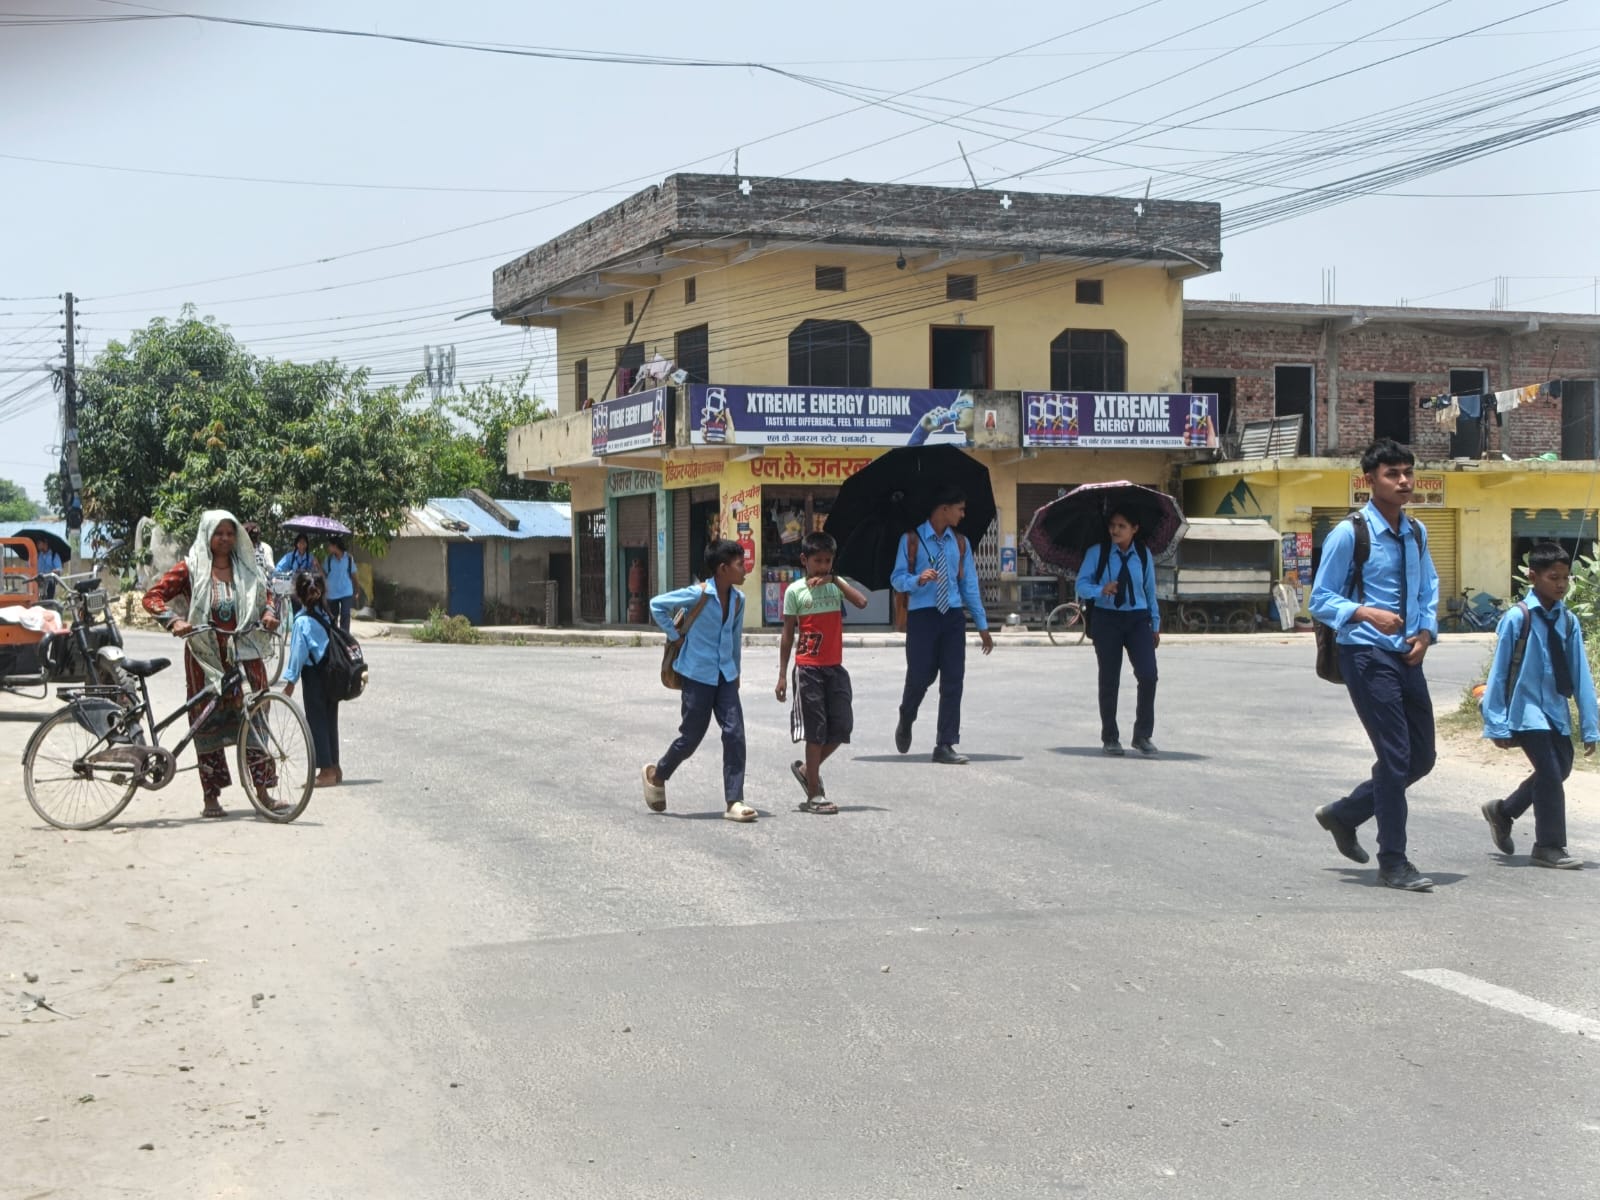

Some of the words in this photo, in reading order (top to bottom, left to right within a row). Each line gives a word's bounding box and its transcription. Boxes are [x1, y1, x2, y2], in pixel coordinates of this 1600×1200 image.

[746, 392, 806, 413] XTREME
[809, 393, 864, 414] ENERGY
[868, 395, 911, 415] DRINK
[1094, 395, 1170, 418] XTREME
[765, 416, 783, 426] TASTE
[785, 417, 797, 427] THE
[798, 417, 836, 428] DIFFERENCE,
[837, 418, 851, 427] FEEL
[853, 418, 865, 427] THE
[866, 418, 891, 428] ENERGY!
[1094, 419, 1134, 433] ENERGY
[1138, 419, 1170, 433] DRINK
